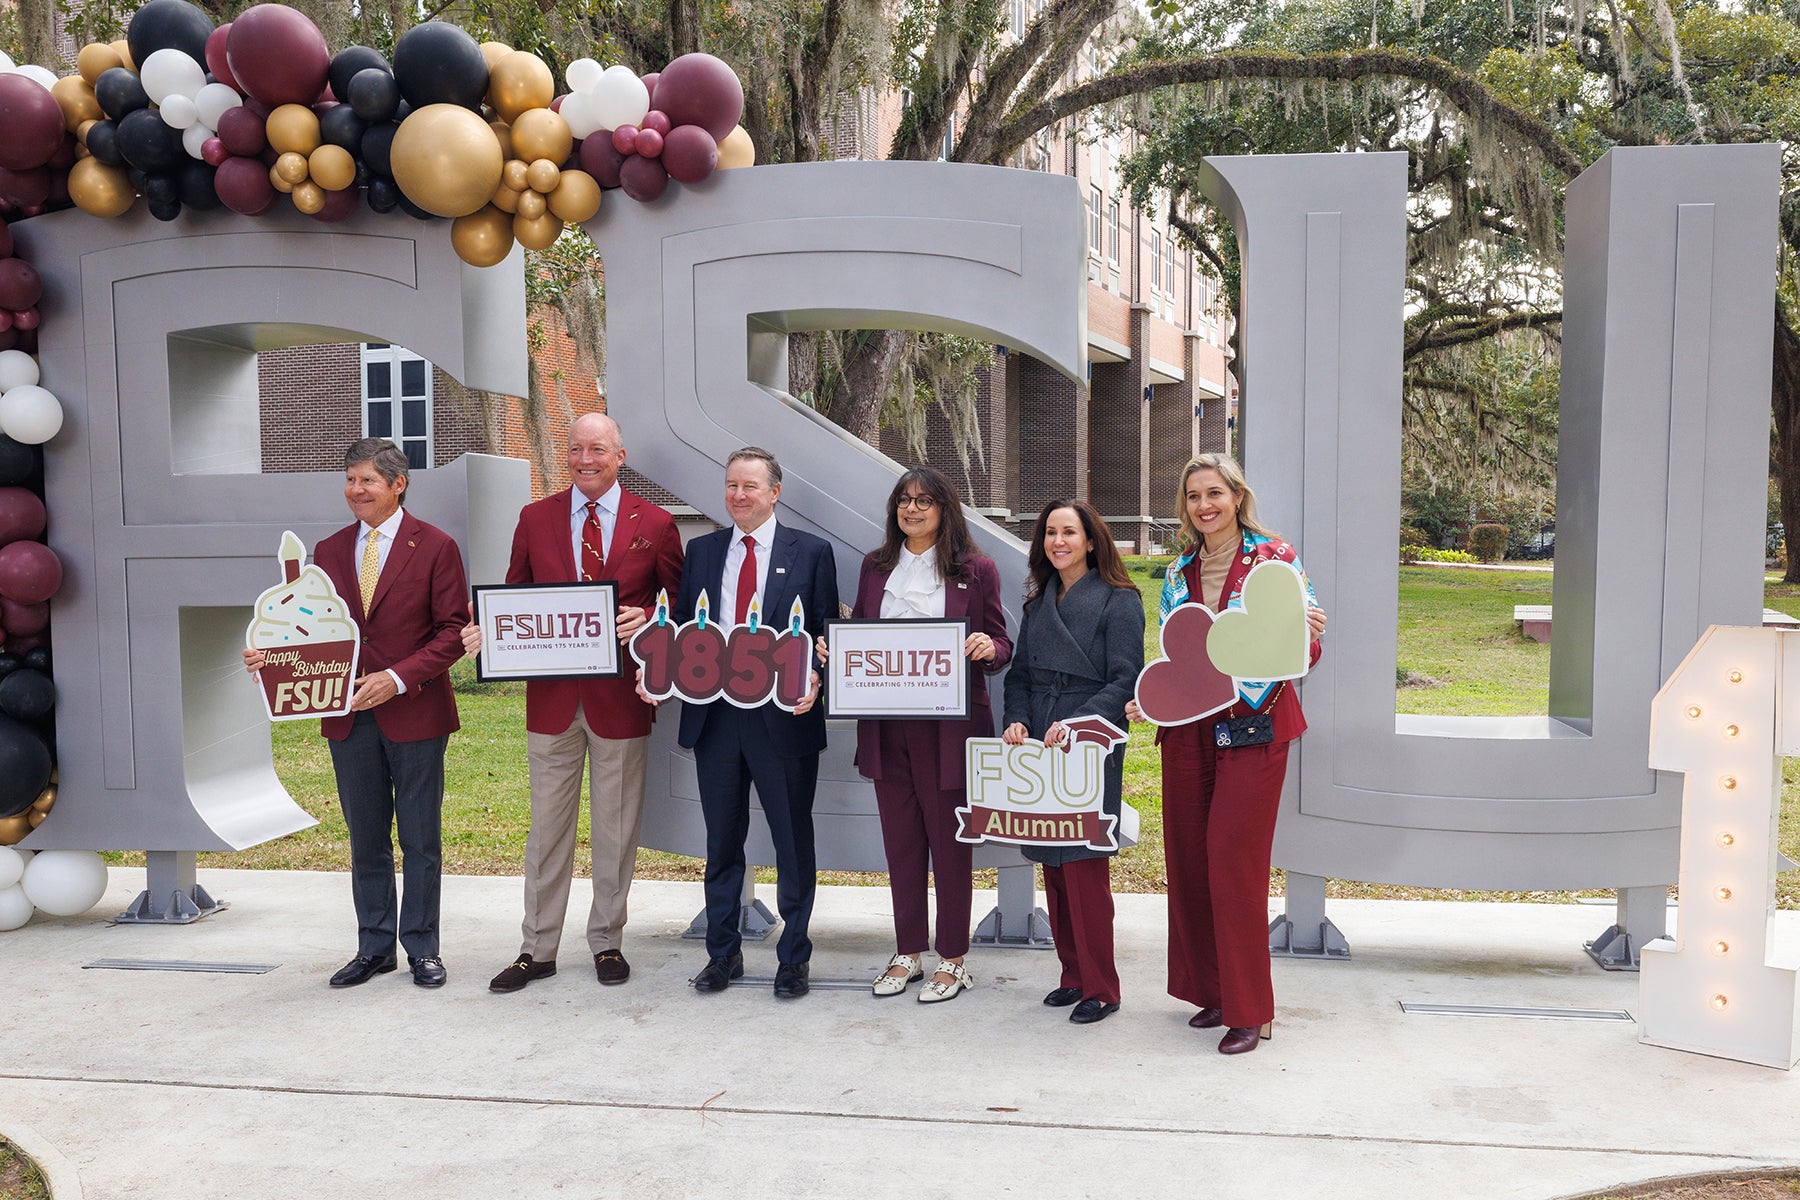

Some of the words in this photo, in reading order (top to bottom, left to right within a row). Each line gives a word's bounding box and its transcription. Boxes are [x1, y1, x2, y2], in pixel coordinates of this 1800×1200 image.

[506, 643, 553, 651] CELEBRATING
[638, 627, 808, 700] 1851
[292, 660, 352, 678] Birthday
[274, 677, 344, 713] FSU!
[969, 741, 1100, 808] FSU
[985, 811, 1084, 839] Alumni
[1638, 624, 1800, 1070] 1
